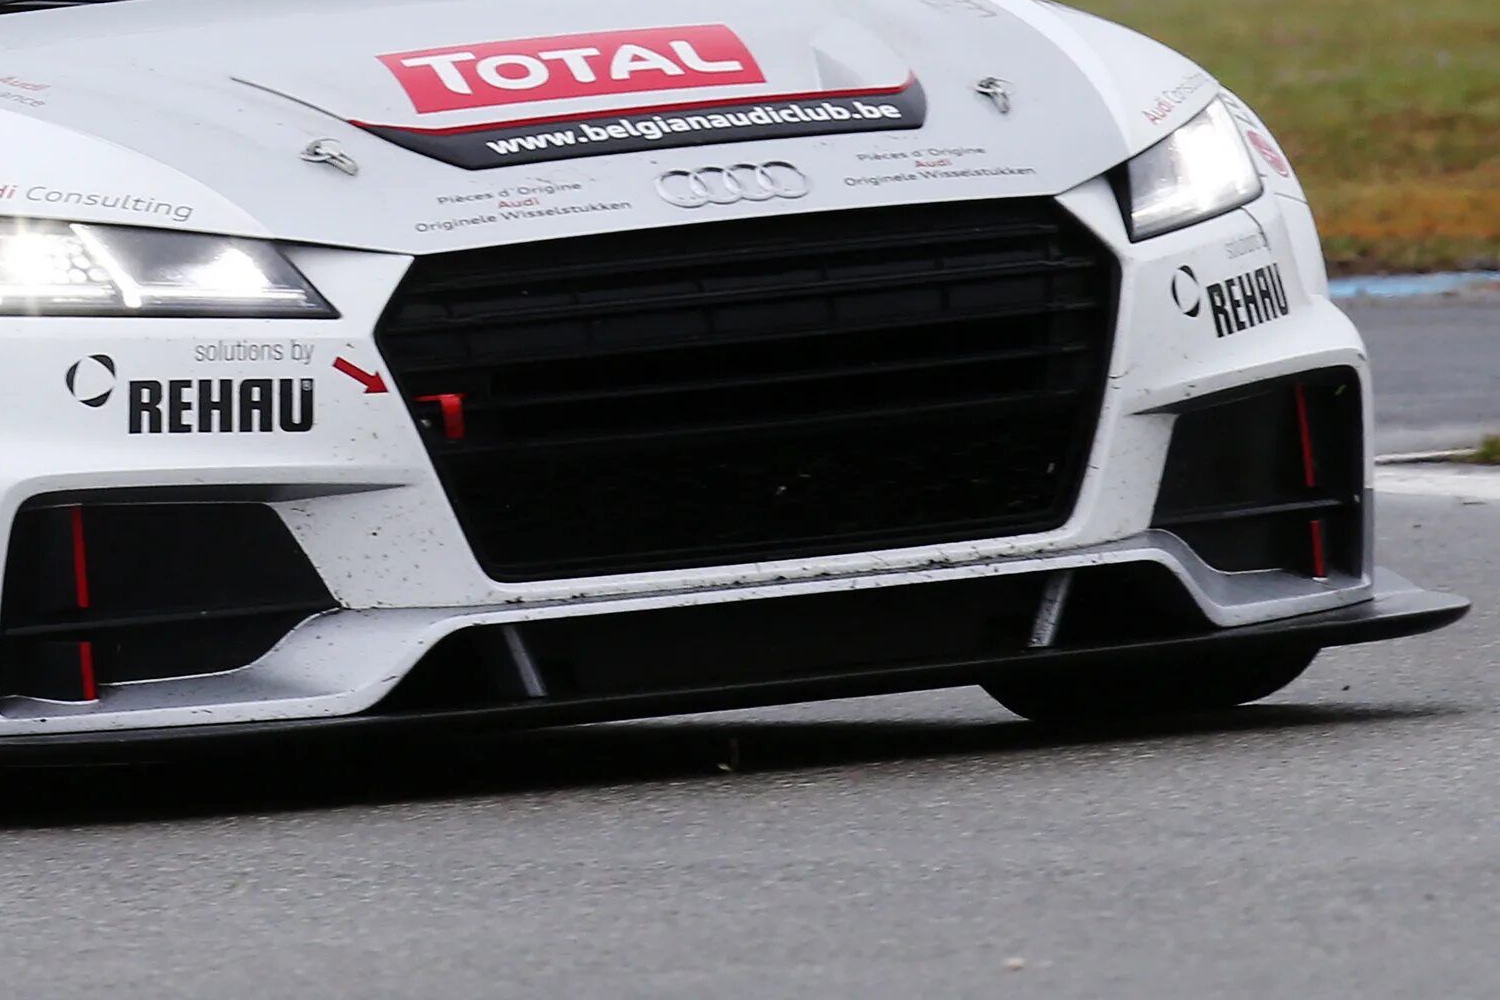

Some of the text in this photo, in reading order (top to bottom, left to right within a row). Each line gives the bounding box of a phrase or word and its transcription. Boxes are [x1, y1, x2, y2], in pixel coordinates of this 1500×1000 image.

[401, 39, 743, 97] TOTAL
[487, 101, 901, 156] www.belgianaudiclub.be
[844, 172, 917, 187] Originele
[26, 186, 193, 222] Consulting
[415, 200, 633, 232] Originele Wisselstukken
[498, 197, 540, 209] Audi
[1206, 263, 1289, 338] REHAU
[195, 339, 315, 365] solutions by
